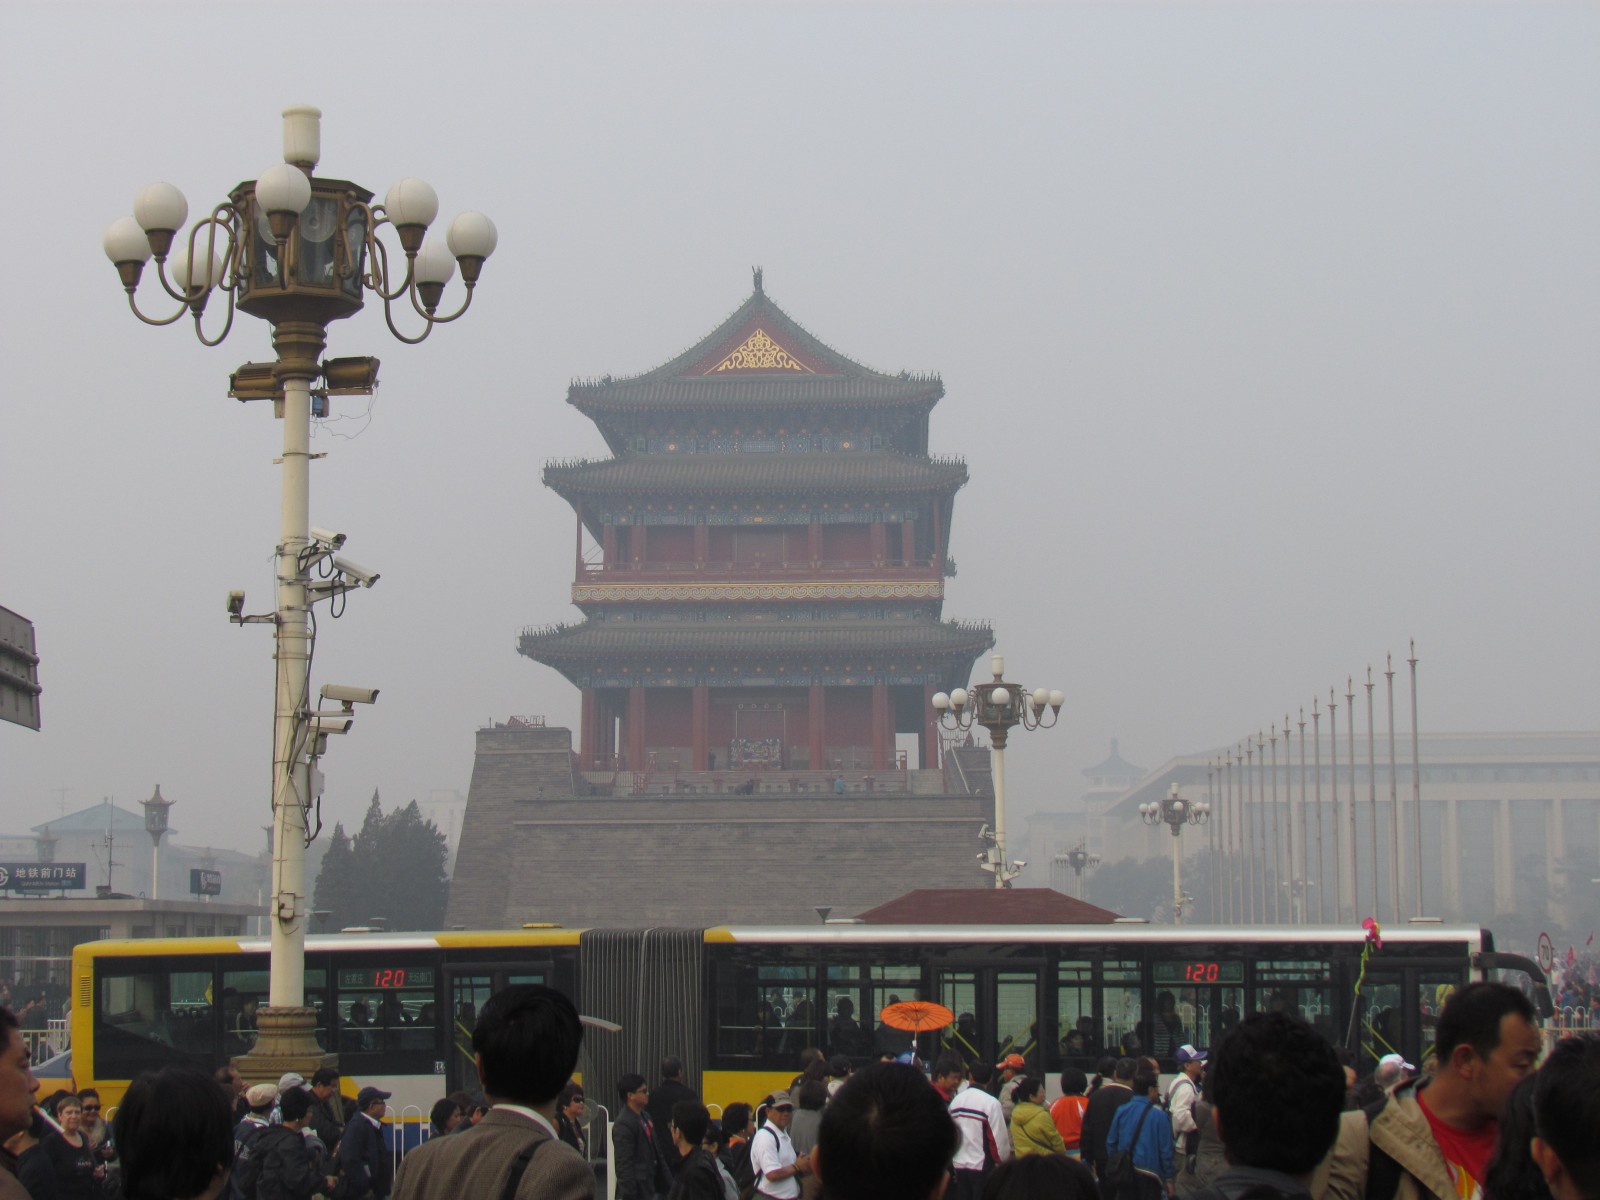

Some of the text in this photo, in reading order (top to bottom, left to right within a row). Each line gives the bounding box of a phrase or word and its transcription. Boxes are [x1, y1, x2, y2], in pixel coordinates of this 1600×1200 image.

[15, 868, 77, 878] 地铁前门站
[374, 969, 405, 987] 120
[1185, 963, 1219, 982] 120
